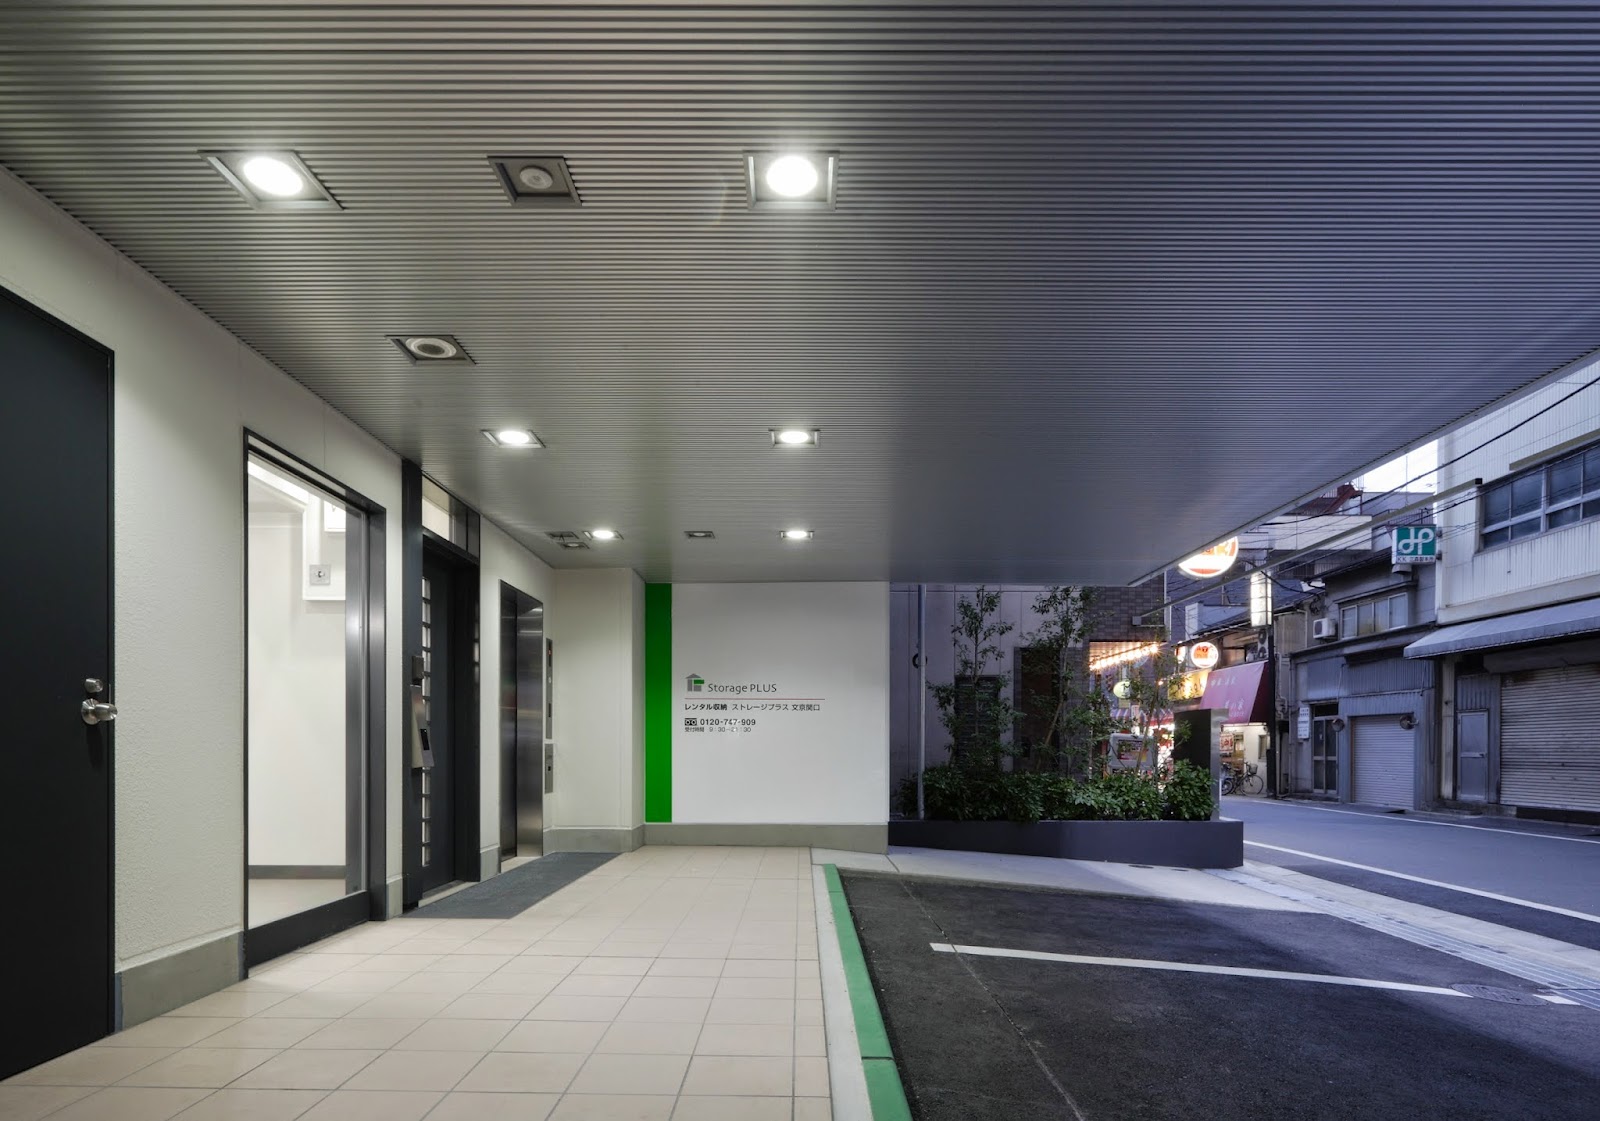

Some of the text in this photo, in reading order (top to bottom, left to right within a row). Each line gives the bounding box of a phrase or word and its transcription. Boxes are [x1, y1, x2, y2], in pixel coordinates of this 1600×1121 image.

[708, 683, 777, 695] Storage PLUS
[684, 703, 821, 712] レンタル収納 ストレージプラス 文京関口
